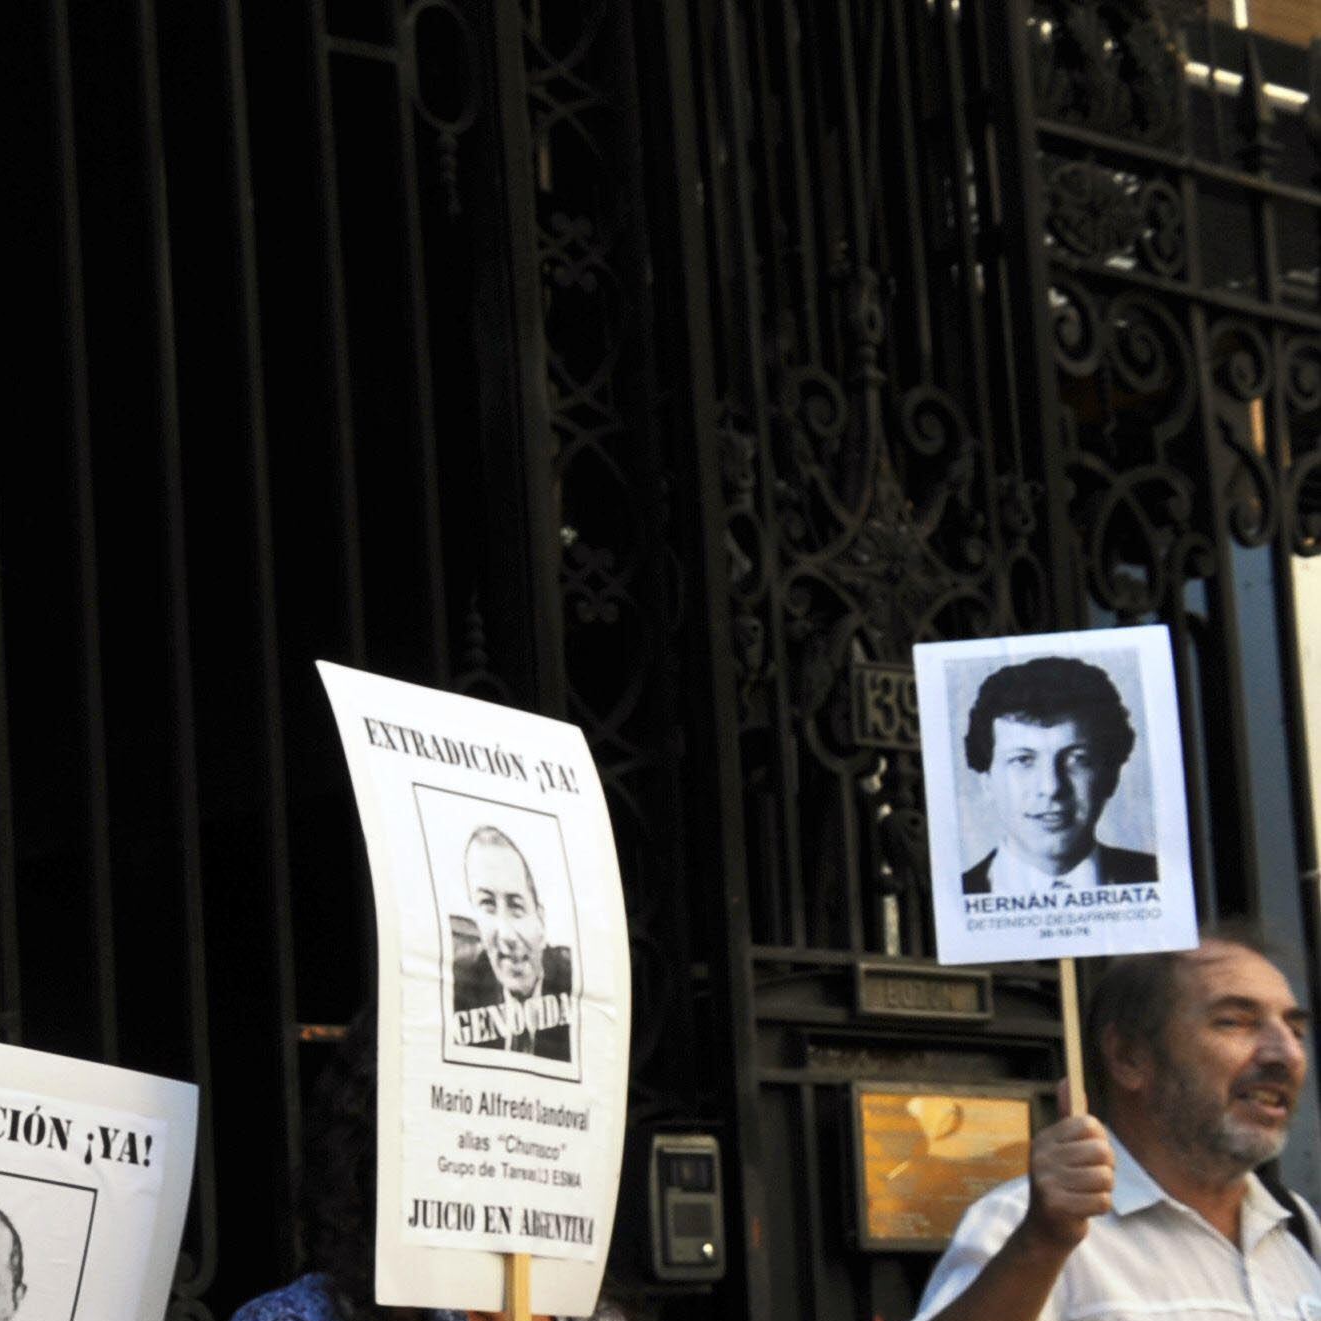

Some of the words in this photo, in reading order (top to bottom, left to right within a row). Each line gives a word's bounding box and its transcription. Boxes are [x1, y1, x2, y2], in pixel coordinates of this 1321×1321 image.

[362, 716, 527, 782] EXTRADICIÓN
[535, 760, 581, 795] ¡YA!
[965, 892, 1057, 914] HERNÁN
[1064, 887, 1160, 908] ABRIATA
[431, 1085, 473, 1115] Mario
[83, 1124, 155, 1169] ¡YA!
[457, 1131, 490, 1152] alias
[438, 1156, 476, 1178] Grupo
[478, 1162, 496, 1177] de
[408, 1198, 475, 1231] JUICIO
[483, 1205, 512, 1234] EN
